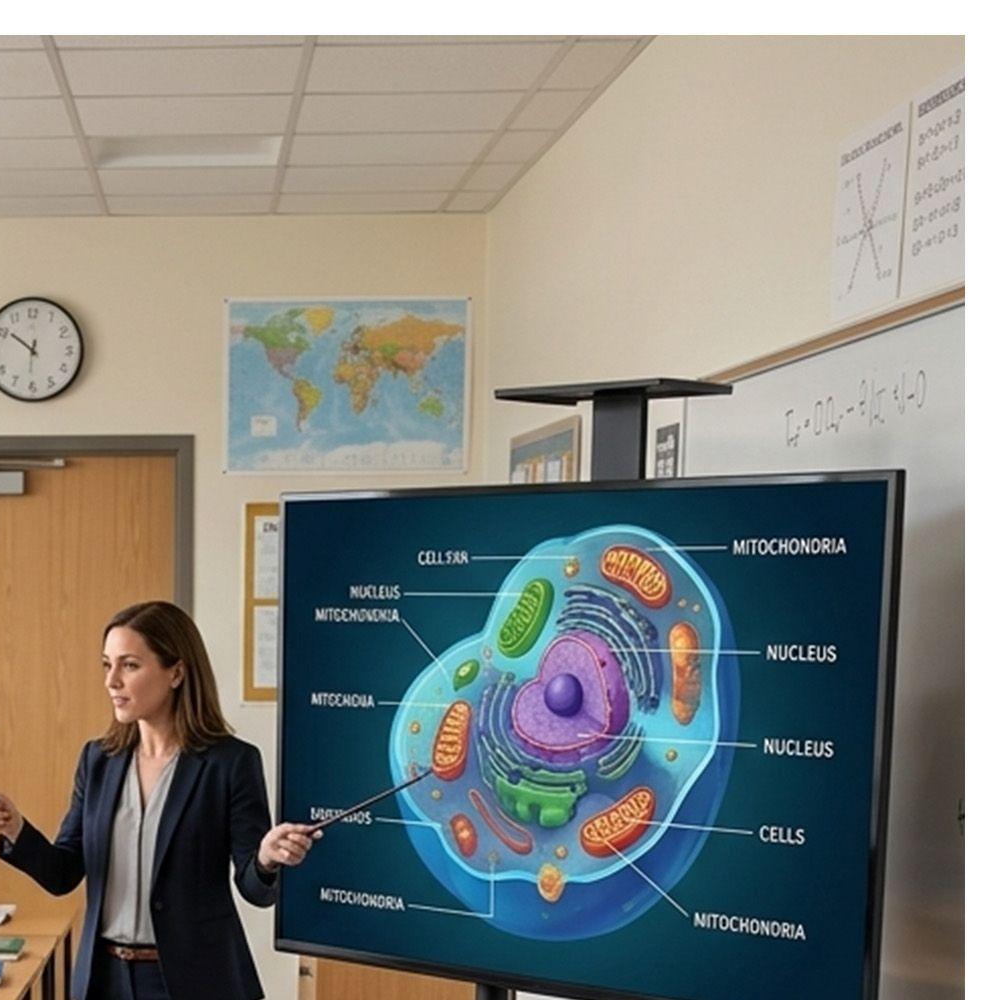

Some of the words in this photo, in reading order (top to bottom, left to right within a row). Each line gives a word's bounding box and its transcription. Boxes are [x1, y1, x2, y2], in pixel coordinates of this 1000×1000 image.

[350, 585, 401, 600] NUCLEUS
[766, 644, 837, 663] NUCLEUS
[763, 738, 834, 758] NUCLEUS
[758, 825, 805, 845] CELLS
